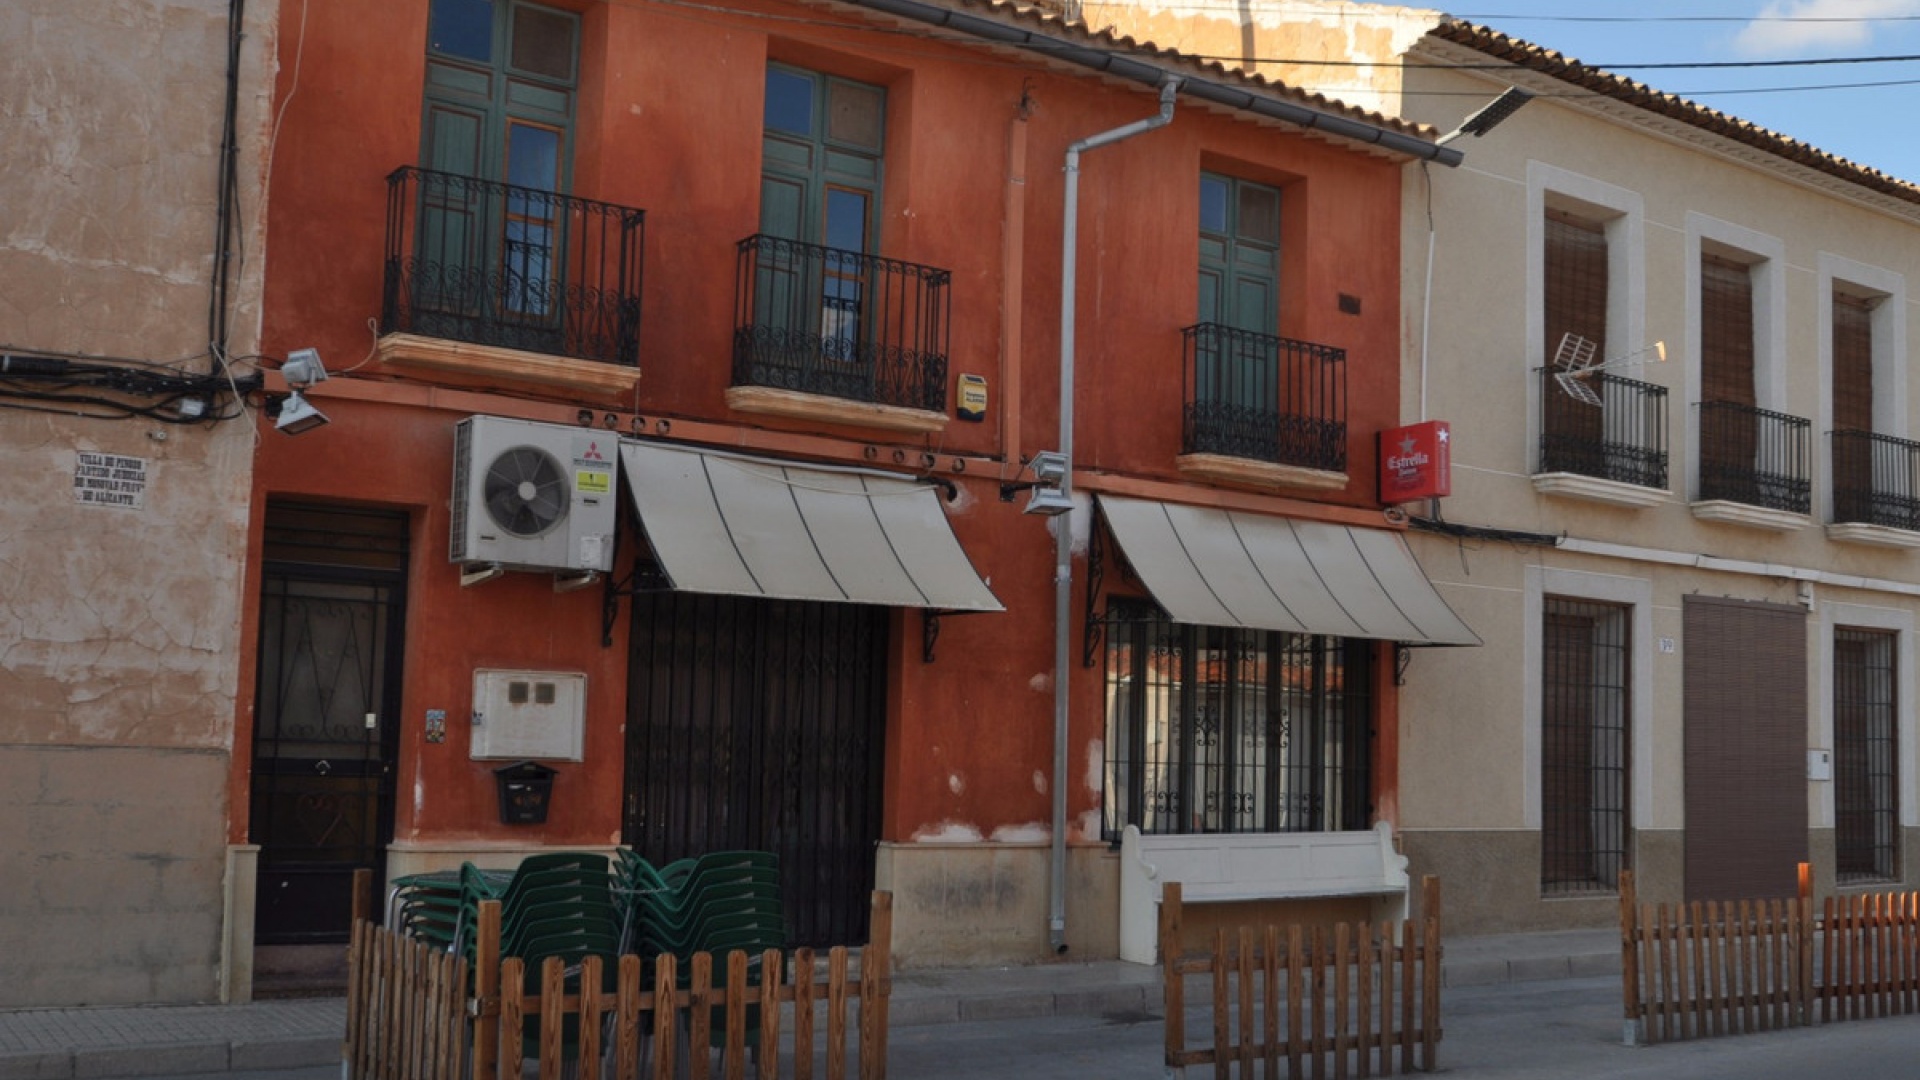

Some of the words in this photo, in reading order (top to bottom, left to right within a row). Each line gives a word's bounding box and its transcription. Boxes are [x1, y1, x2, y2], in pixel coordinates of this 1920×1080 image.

[80, 454, 102, 465] VILLA
[1386, 452, 1429, 470] Estrella
[95, 491, 135, 505] ALICANTE
